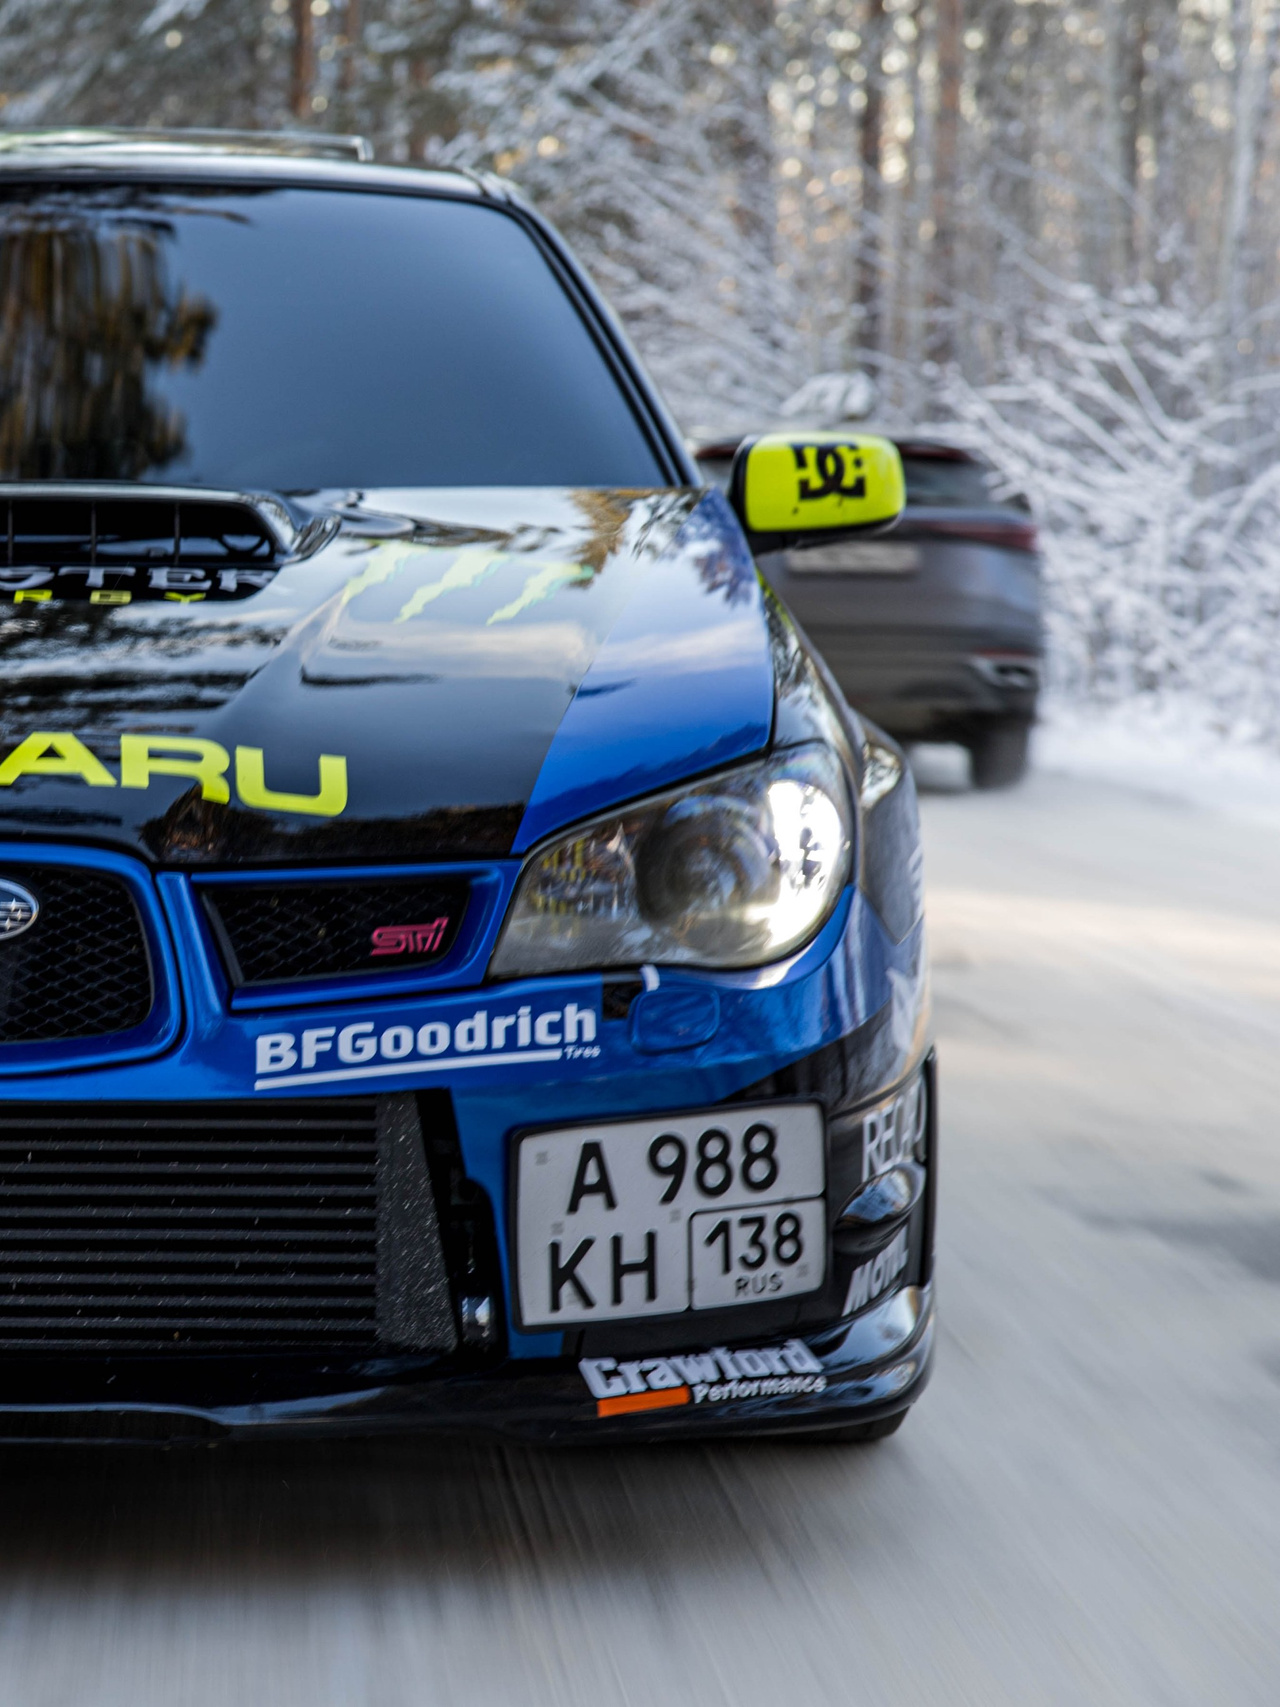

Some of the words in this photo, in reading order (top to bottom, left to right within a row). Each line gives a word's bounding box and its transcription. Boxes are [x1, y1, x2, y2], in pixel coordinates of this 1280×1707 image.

[255, 1003, 597, 1075] BFGoodrich
[564, 1044, 601, 1061] Tires
[567, 1138, 617, 1214] A
[647, 1121, 779, 1205] 988
[549, 1228, 657, 1313] KH
[704, 1212, 804, 1275] 138
[735, 1271, 784, 1297] RUS
[578, 1338, 825, 1398] Crawford
[692, 1375, 827, 1404] Performance
